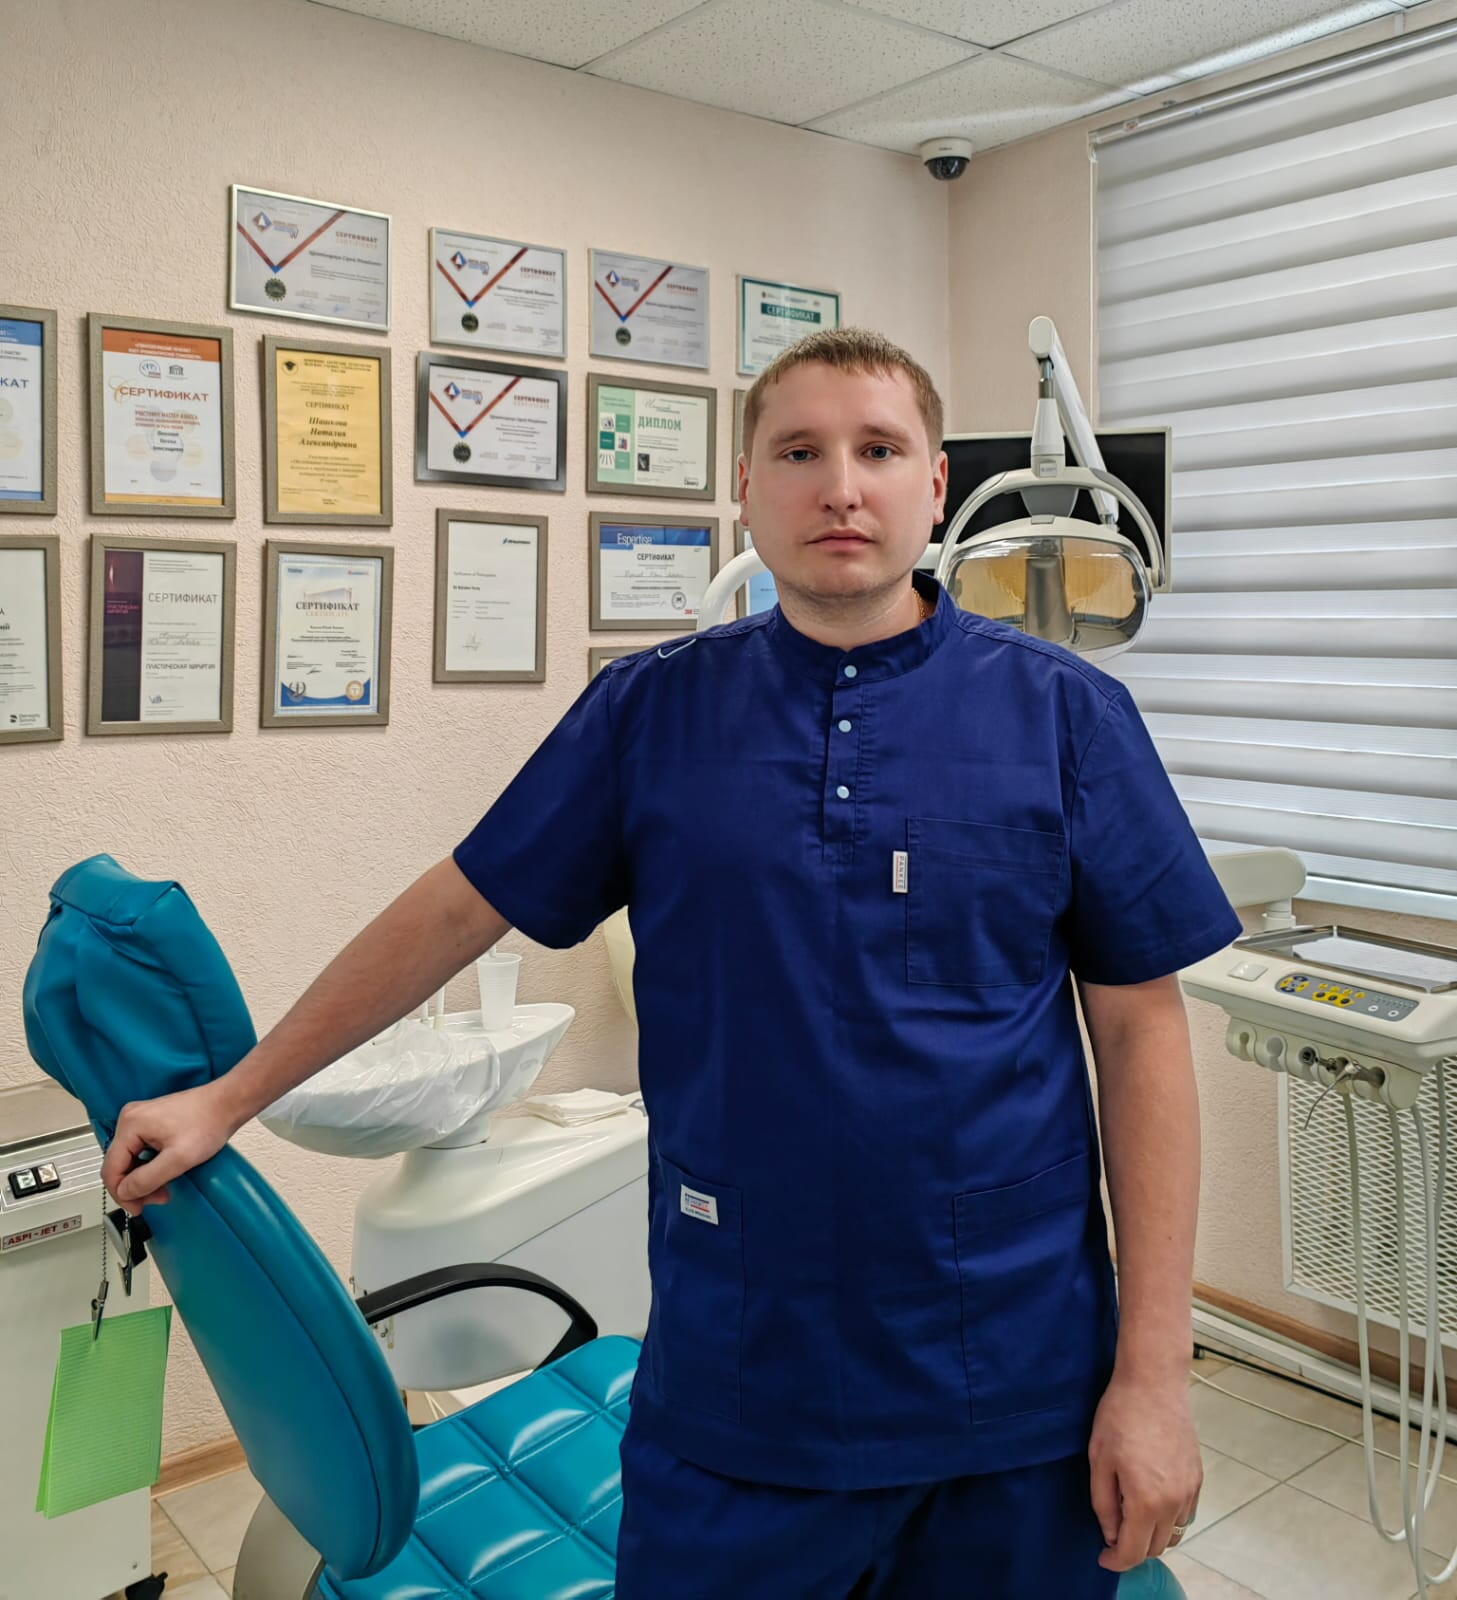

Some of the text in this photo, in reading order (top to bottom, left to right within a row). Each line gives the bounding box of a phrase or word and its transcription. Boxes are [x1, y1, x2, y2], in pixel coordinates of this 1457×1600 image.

[767, 304, 815, 321] СЕРТИФИКАТ
[119, 386, 209, 403] СЕРТИФИКАТ
[305, 401, 350, 412] СЕРТИФИКАТ
[638, 415, 682, 431] ДИПЛОМ
[636, 553, 675, 561] СЕРТИФИКАТ
[148, 592, 219, 604] СЕРТИФИКАТ
[295, 601, 360, 611] СЕРТИФИКАТ
